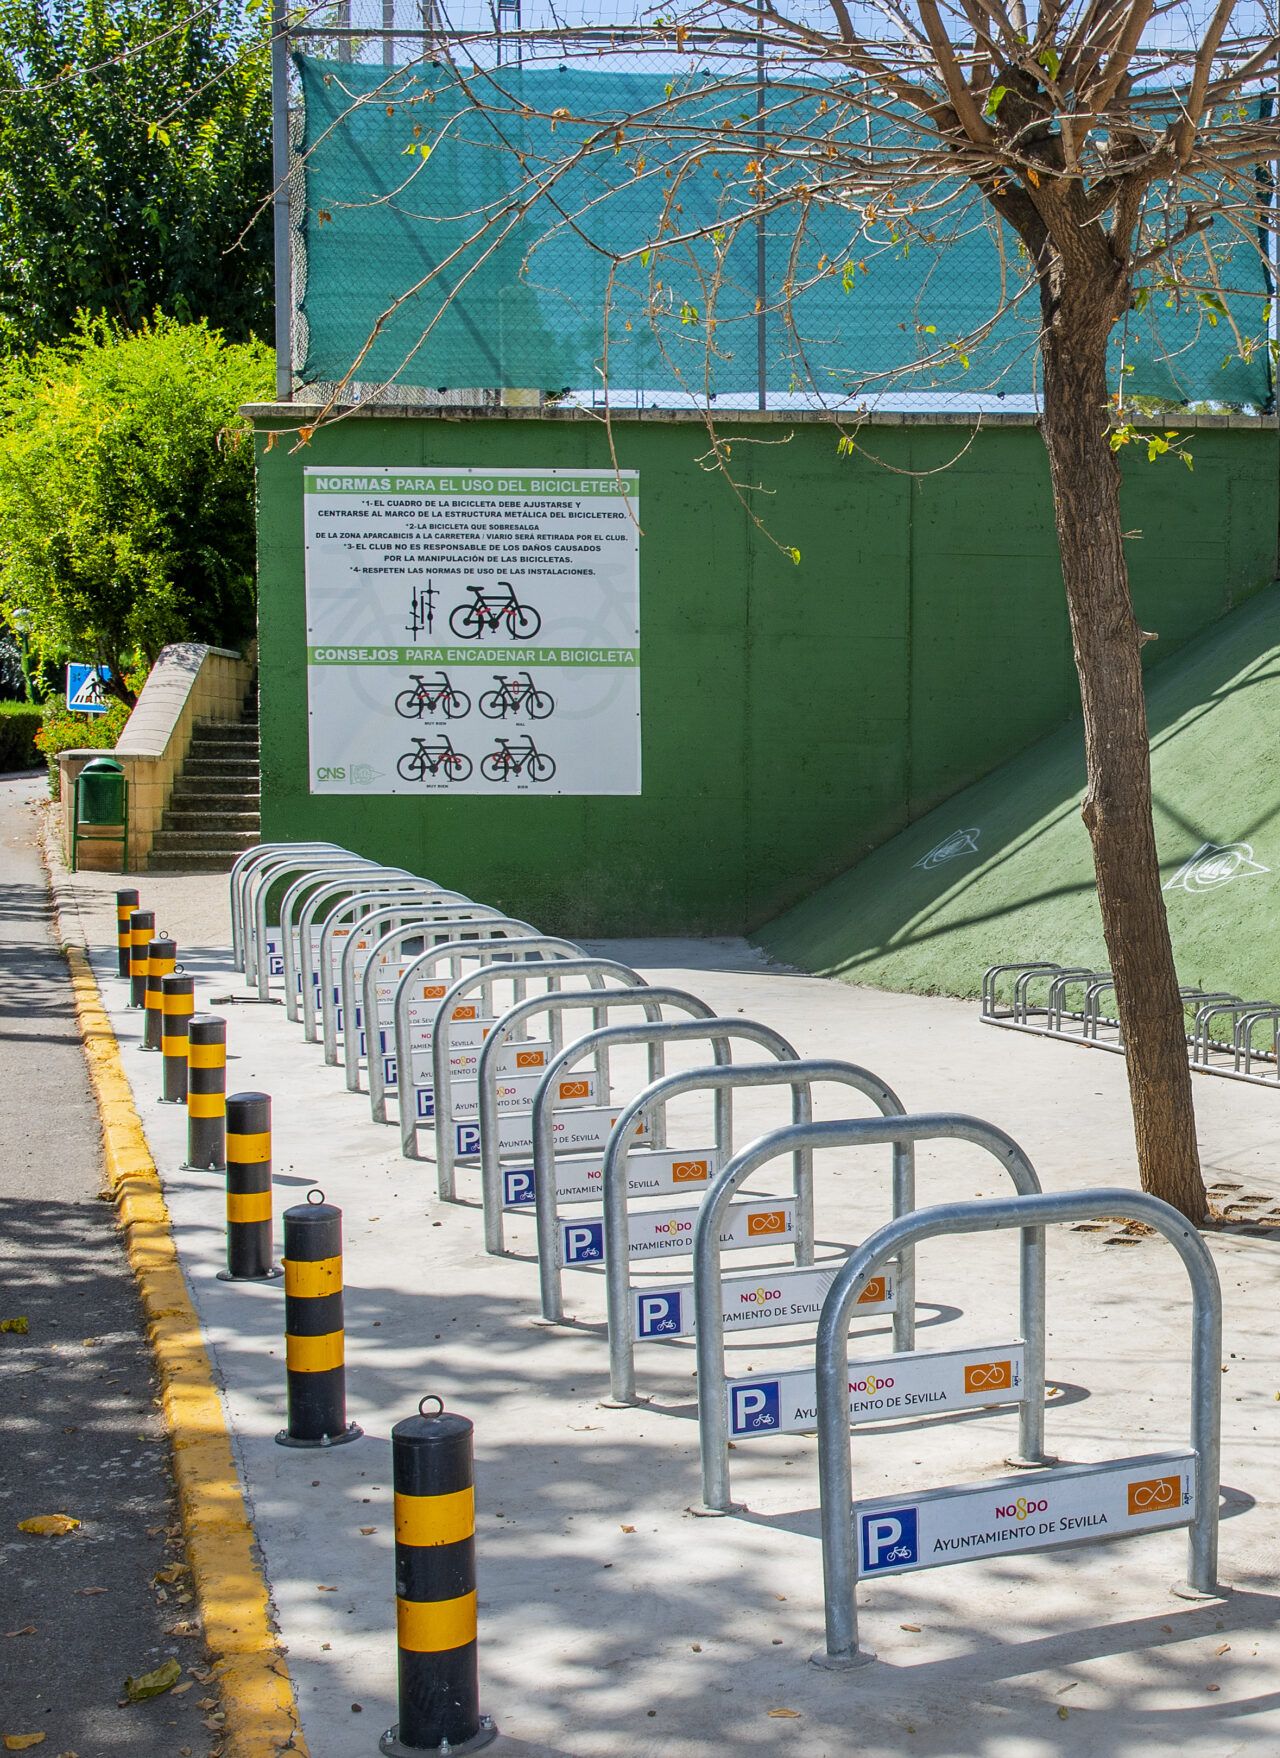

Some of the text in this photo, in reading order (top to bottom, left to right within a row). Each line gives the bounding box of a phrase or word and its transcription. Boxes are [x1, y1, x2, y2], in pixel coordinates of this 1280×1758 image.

[316, 478, 630, 492] NORMAS PARA EL USO DEL BICICLETERO
[505, 510, 547, 518] METÁLICA
[515, 533, 534, 541] SERÁ
[523, 543, 551, 551] DAÑOS
[418, 554, 484, 562] MANIPULACIÓN
[315, 649, 634, 662] CONSEJOS PARA ENCADENAR LA BICICLETA
[317, 767, 346, 780] CNS
[460, 1126, 479, 1152] P
[571, 1134, 600, 1143] SEVILLA
[508, 1174, 530, 1201] P
[628, 1180, 660, 1189] SEVILLA
[568, 1228, 593, 1260] P
[643, 1298, 669, 1333] P
[774, 1307, 788, 1316] DE
[790, 1303, 822, 1315] SEVILL
[886, 1396, 901, 1407] DE
[904, 1391, 947, 1405] SEVILLA
[736, 1389, 766, 1429] P
[933, 1513, 1108, 1552] AYUNTAMIENTO DE SEVILLA
[867, 1517, 903, 1565] P
